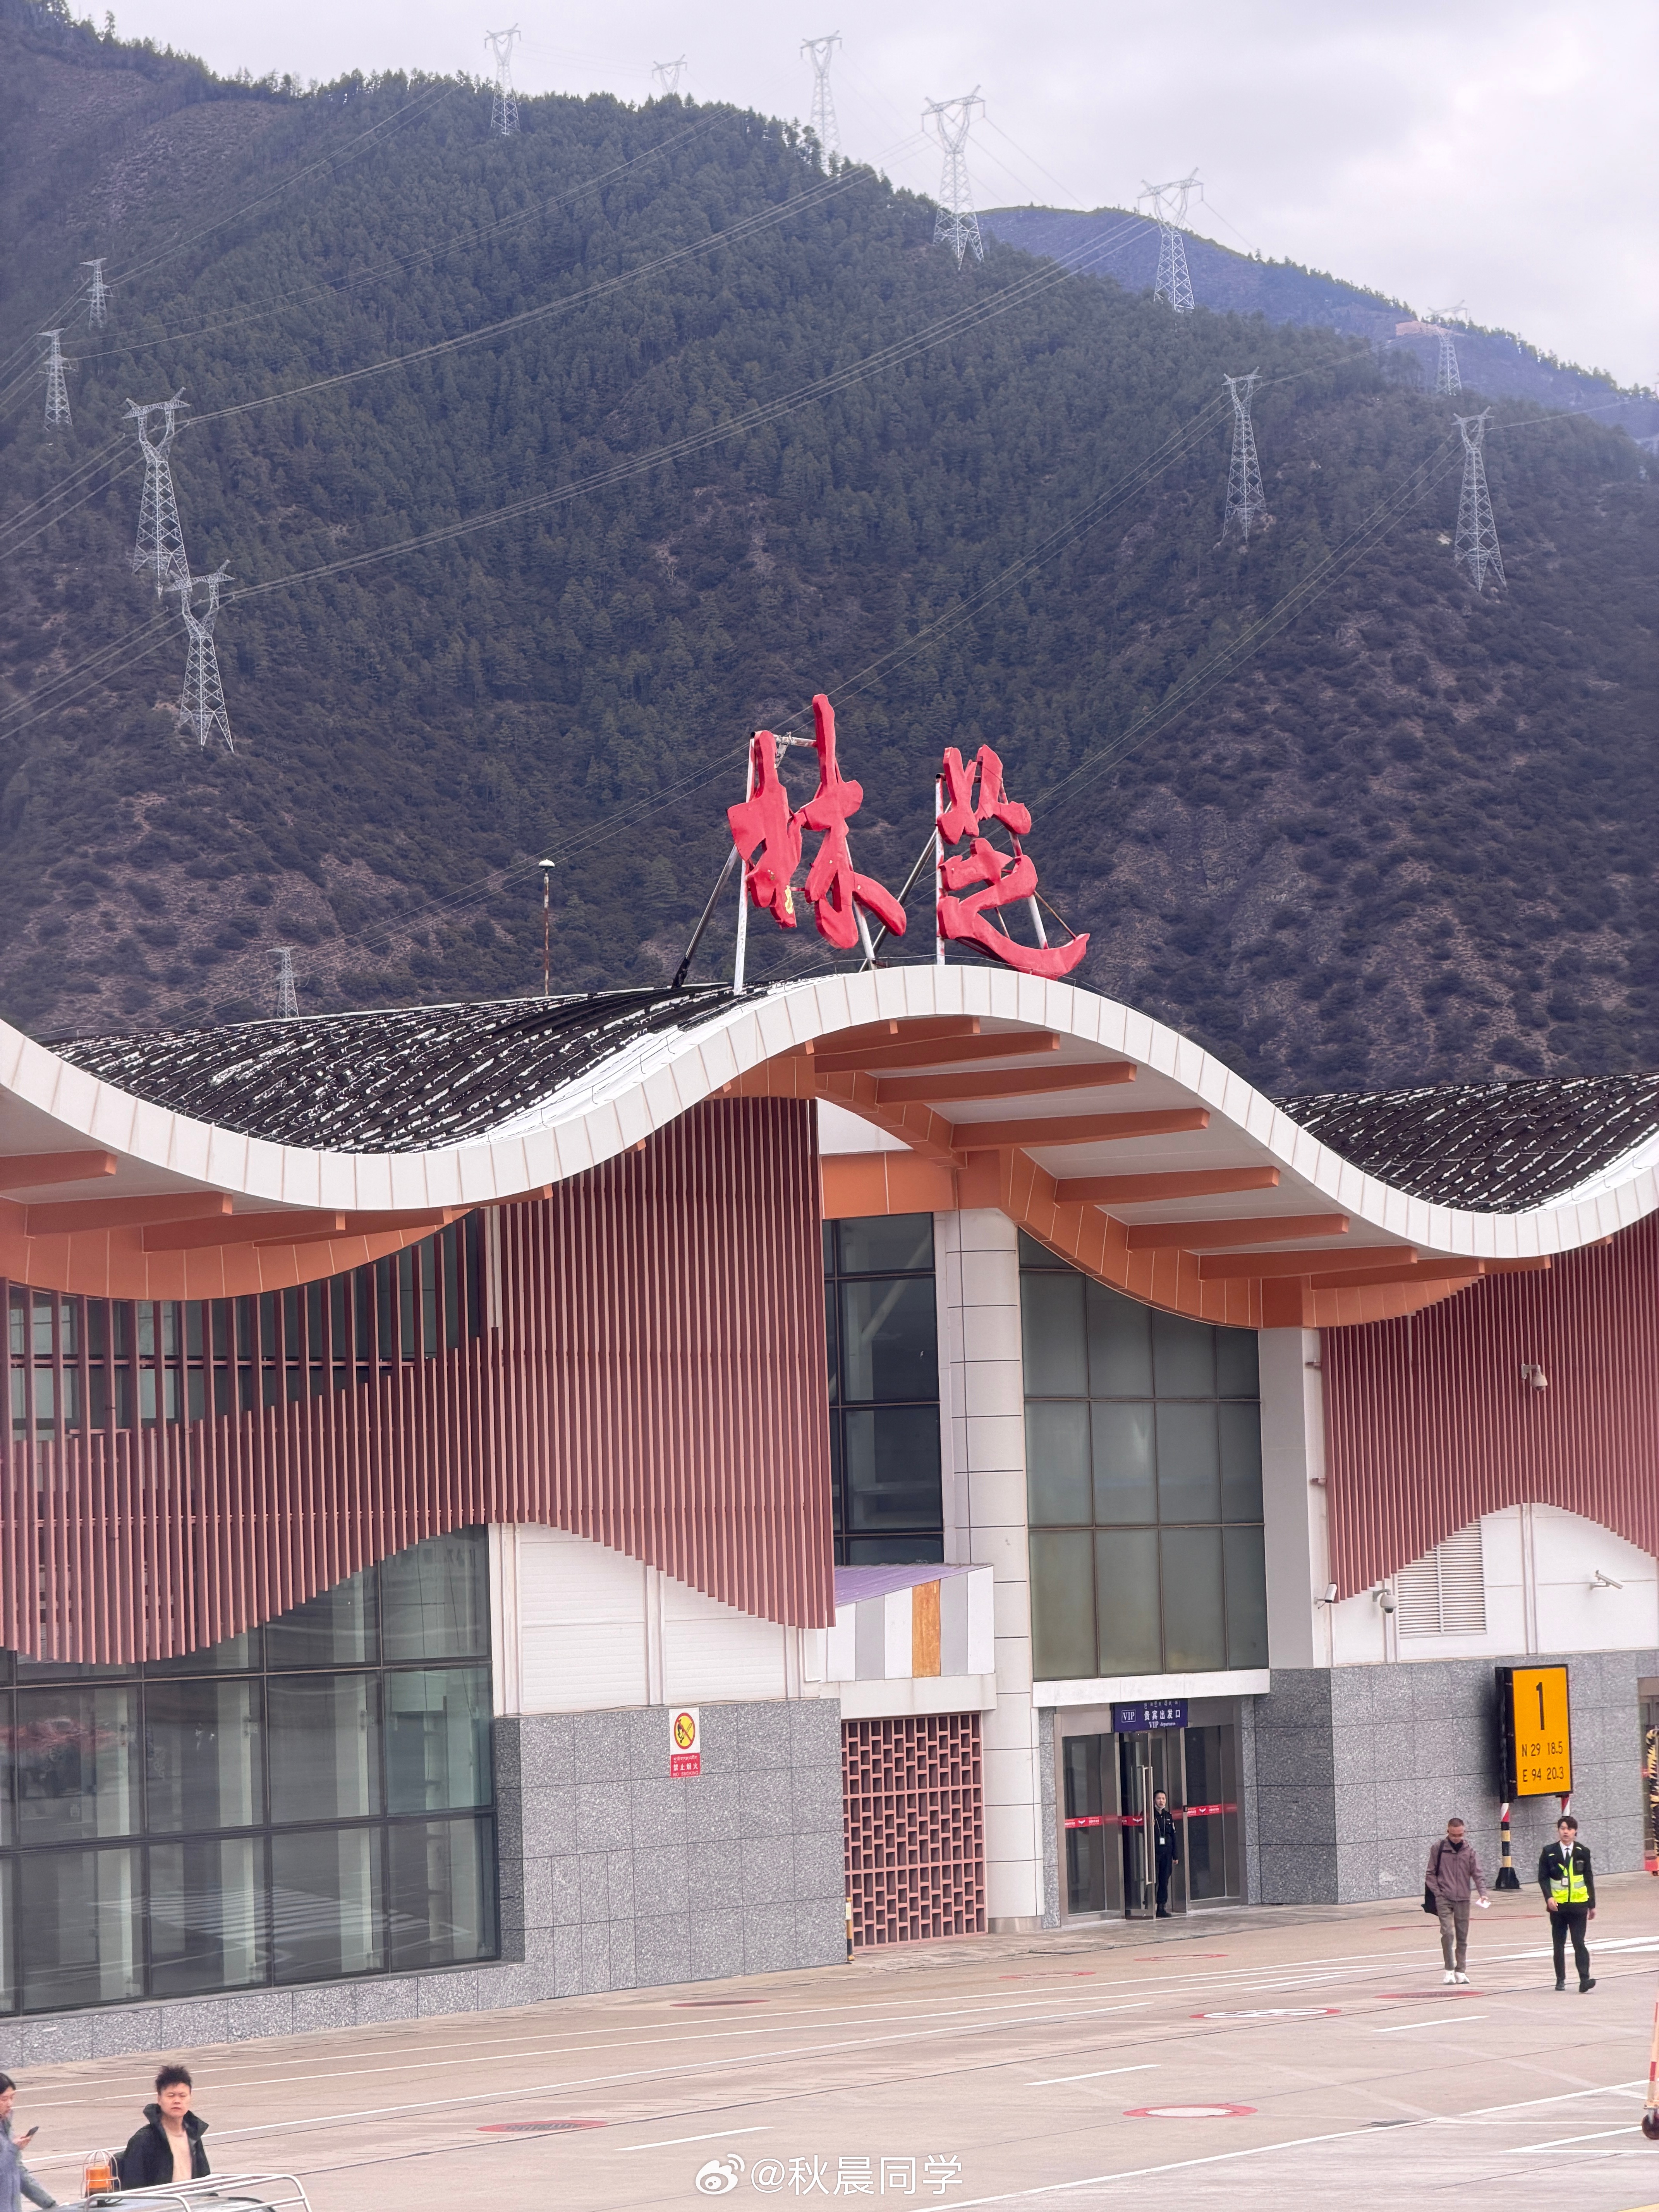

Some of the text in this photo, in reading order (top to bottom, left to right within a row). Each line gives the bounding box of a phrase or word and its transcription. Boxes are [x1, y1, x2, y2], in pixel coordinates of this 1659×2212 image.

[727, 694, 1089, 979] 林芝
[1536, 1682, 1545, 1731] 1
[1123, 1711, 1135, 1721] VIP
[1144, 1709, 1180, 1721] 贵宾出发口
[1522, 1741, 1563, 1757] N 29 18.5
[673, 1762, 698, 1771] 禁止烟火
[1523, 1766, 1564, 1782] E 94 20.3
